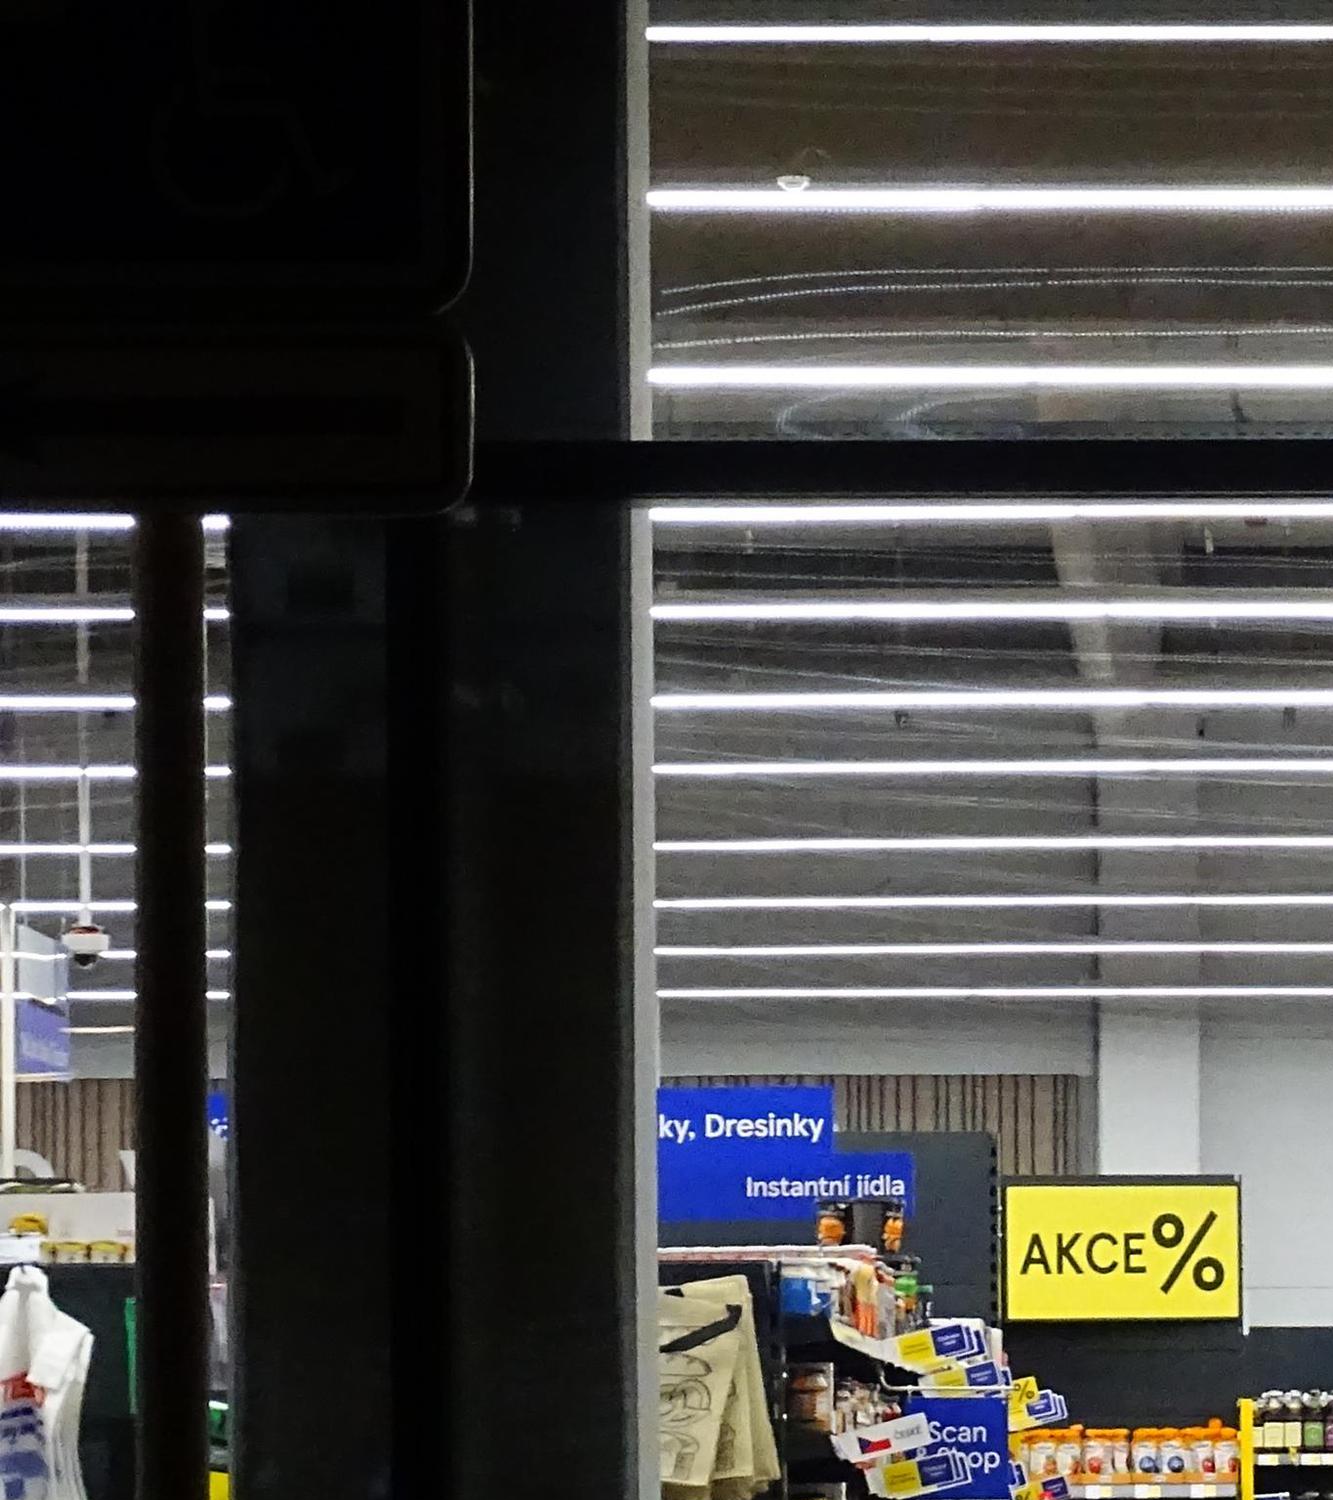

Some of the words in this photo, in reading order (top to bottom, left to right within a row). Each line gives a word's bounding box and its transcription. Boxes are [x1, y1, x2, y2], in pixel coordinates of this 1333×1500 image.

[704, 1112, 825, 1143] Dresinky
[746, 1174, 850, 1198] Instantní
[856, 1174, 905, 1198] jídla
[1019, 1210, 1225, 1295] AKCE%
[929, 1420, 987, 1443] Scan
